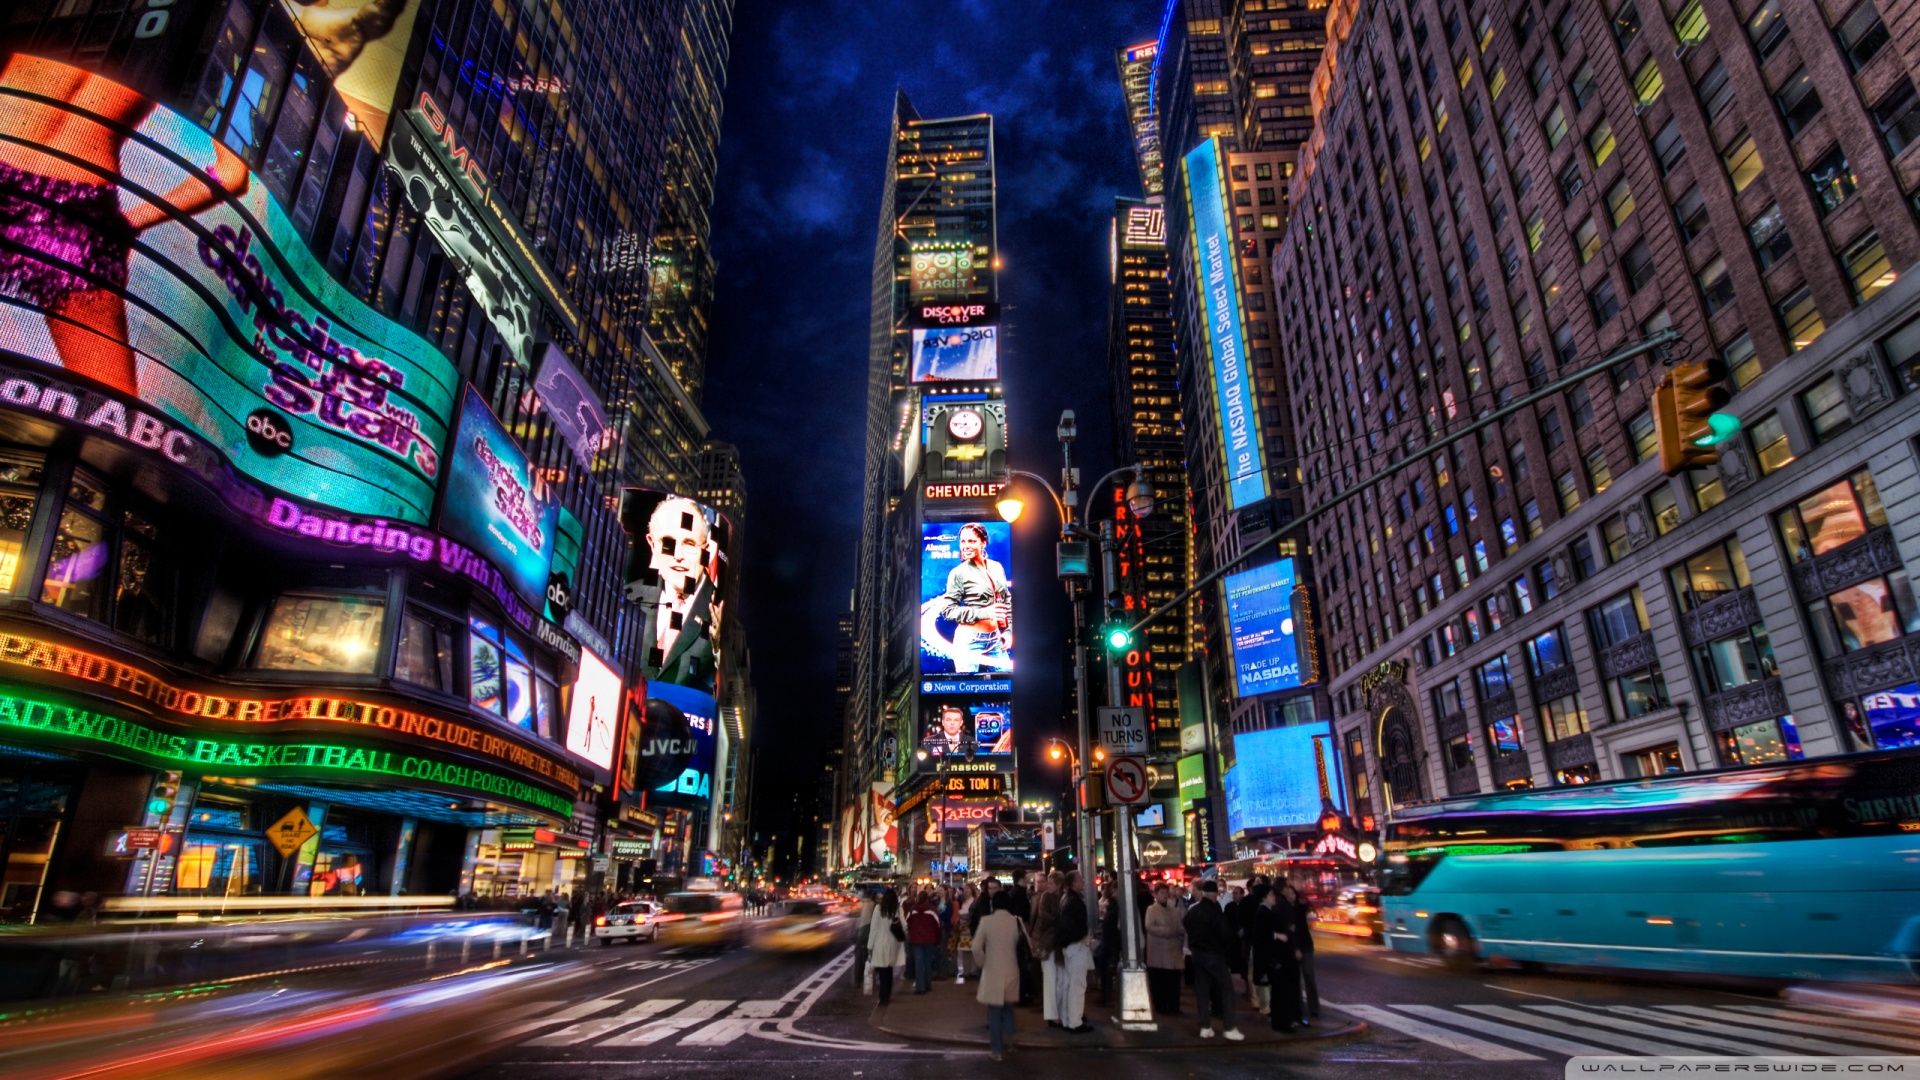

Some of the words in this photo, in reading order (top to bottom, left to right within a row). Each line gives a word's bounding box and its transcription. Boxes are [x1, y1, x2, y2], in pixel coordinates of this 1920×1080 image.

[420, 91, 488, 197] GMC
[410, 134, 423, 155] THE
[422, 151, 437, 173] NEW
[435, 169, 450, 191] 2007
[450, 188, 490, 247] YUKON
[490, 199, 502, 220] WE
[502, 218, 517, 240] ARE
[516, 236, 560, 301] PROFESSIONAL
[1206, 232, 1226, 287] Market
[917, 277, 968, 290] TARGET
[922, 305, 986, 318] DISCOVER
[939, 315, 970, 324] CARD
[1216, 286, 1232, 334] Select
[1220, 333, 1240, 384] Global
[0, 378, 79, 420] on
[86, 398, 193, 465] ABC
[1225, 383, 1249, 452] NASDAQ
[246, 414, 292, 449] abc
[1237, 450, 1252, 485] The
[926, 483, 1006, 498] CHEVROLET
[267, 496, 435, 562] Dancing
[439, 536, 490, 587] With
[1268, 657, 1280, 667] UP
[933, 682, 956, 692] News
[958, 682, 1010, 693] Corporation
[978, 719, 1000, 730] 80
[1111, 713, 1132, 728] NO
[356, 702, 397, 728] TO
[400, 709, 481, 751] INCLUDE
[481, 733, 510, 759] DRY
[1103, 728, 1144, 744] TURNS
[65, 706, 188, 760] WOMEN'S
[194, 739, 397, 774] BASKETBALL
[401, 755, 470, 788] COACH
[470, 769, 514, 798] POKEY
[641, 738, 681, 757] JVC
[683, 739, 698, 755] JV
[936, 762, 997, 772] Pnasonic
[969, 777, 990, 790] TOM
[504, 841, 536, 850] SEPHORA
[617, 847, 644, 855] COFFEE
